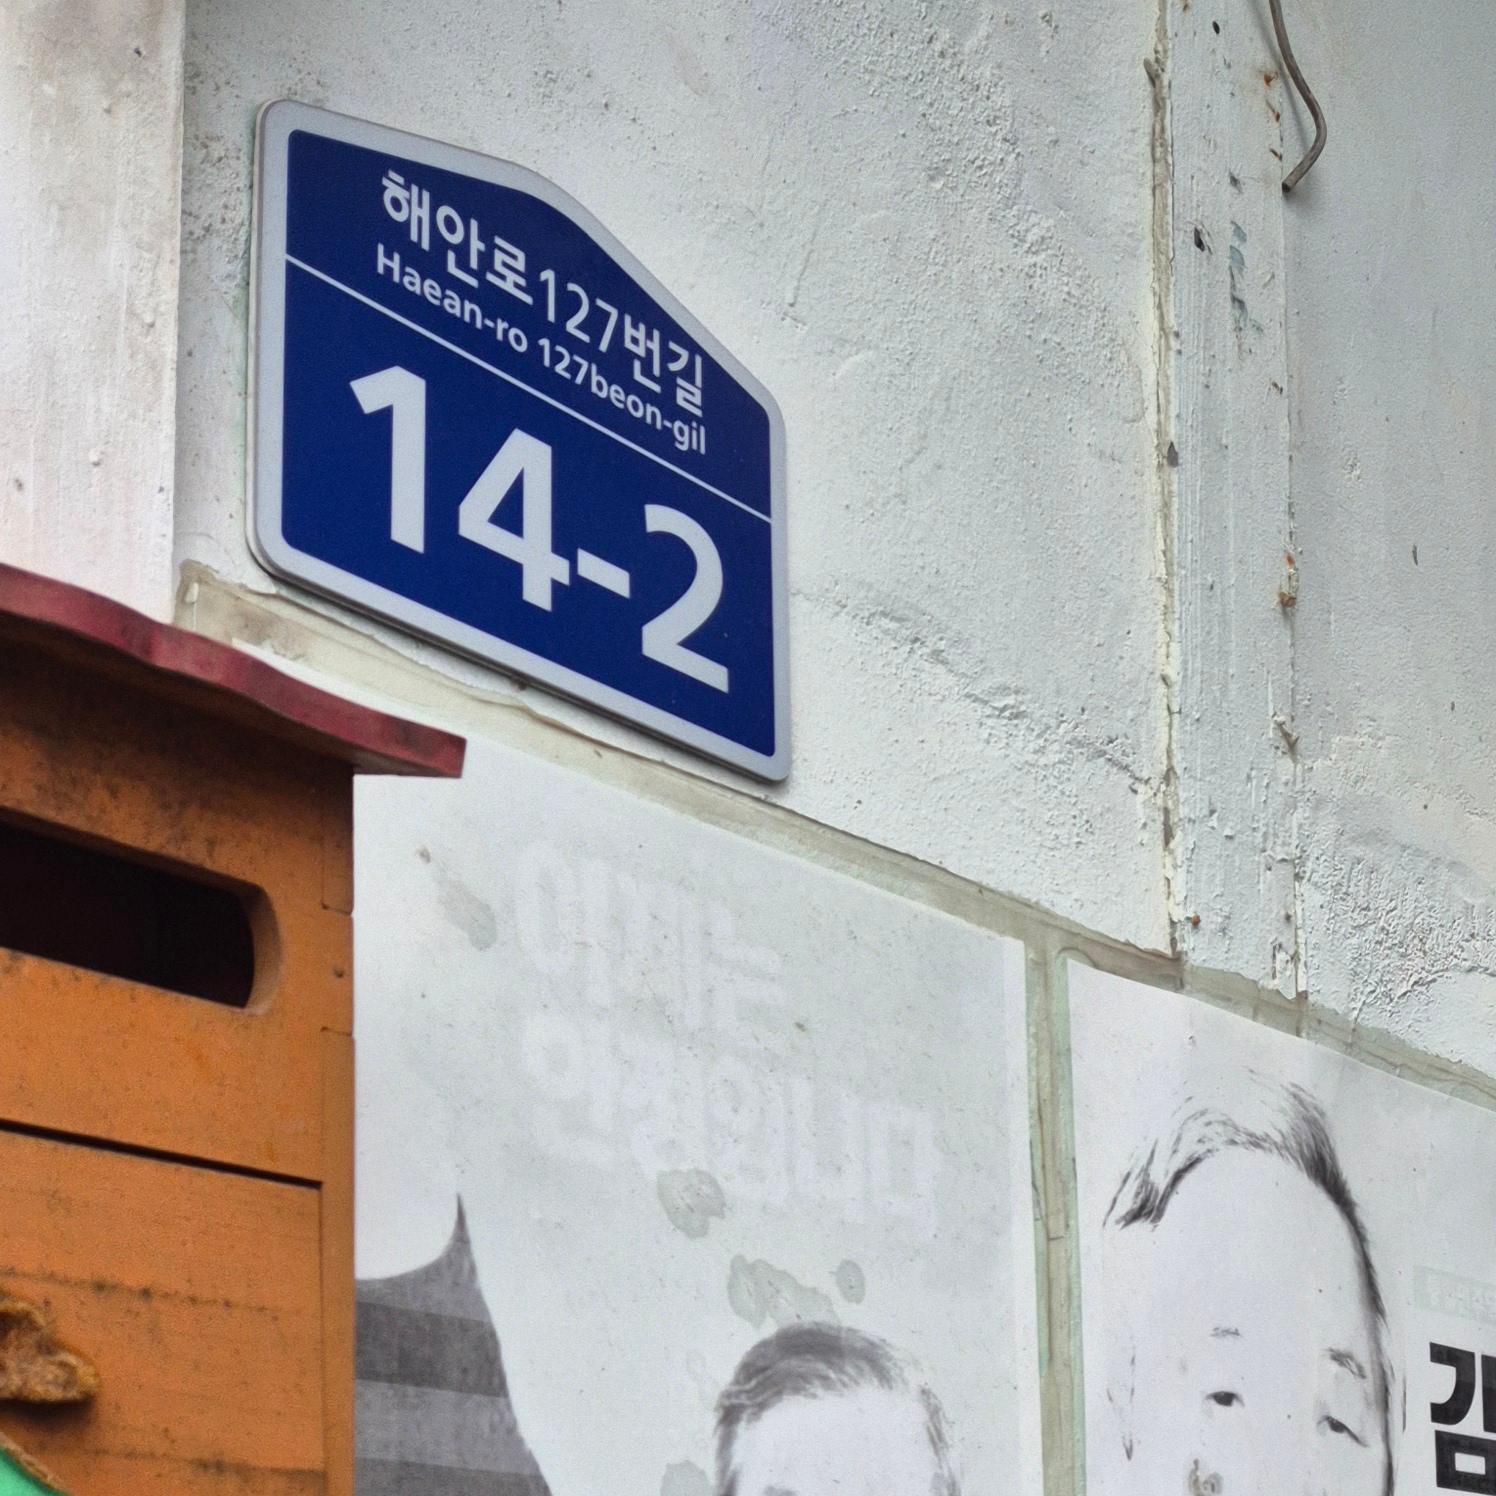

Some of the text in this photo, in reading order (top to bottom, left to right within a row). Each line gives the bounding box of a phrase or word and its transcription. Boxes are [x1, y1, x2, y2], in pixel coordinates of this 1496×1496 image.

[377, 243, 706, 456] Haean-ro 127beon-gil
[382, 169, 703, 418] 해안로127번길
[349, 365, 729, 693] 14-2
